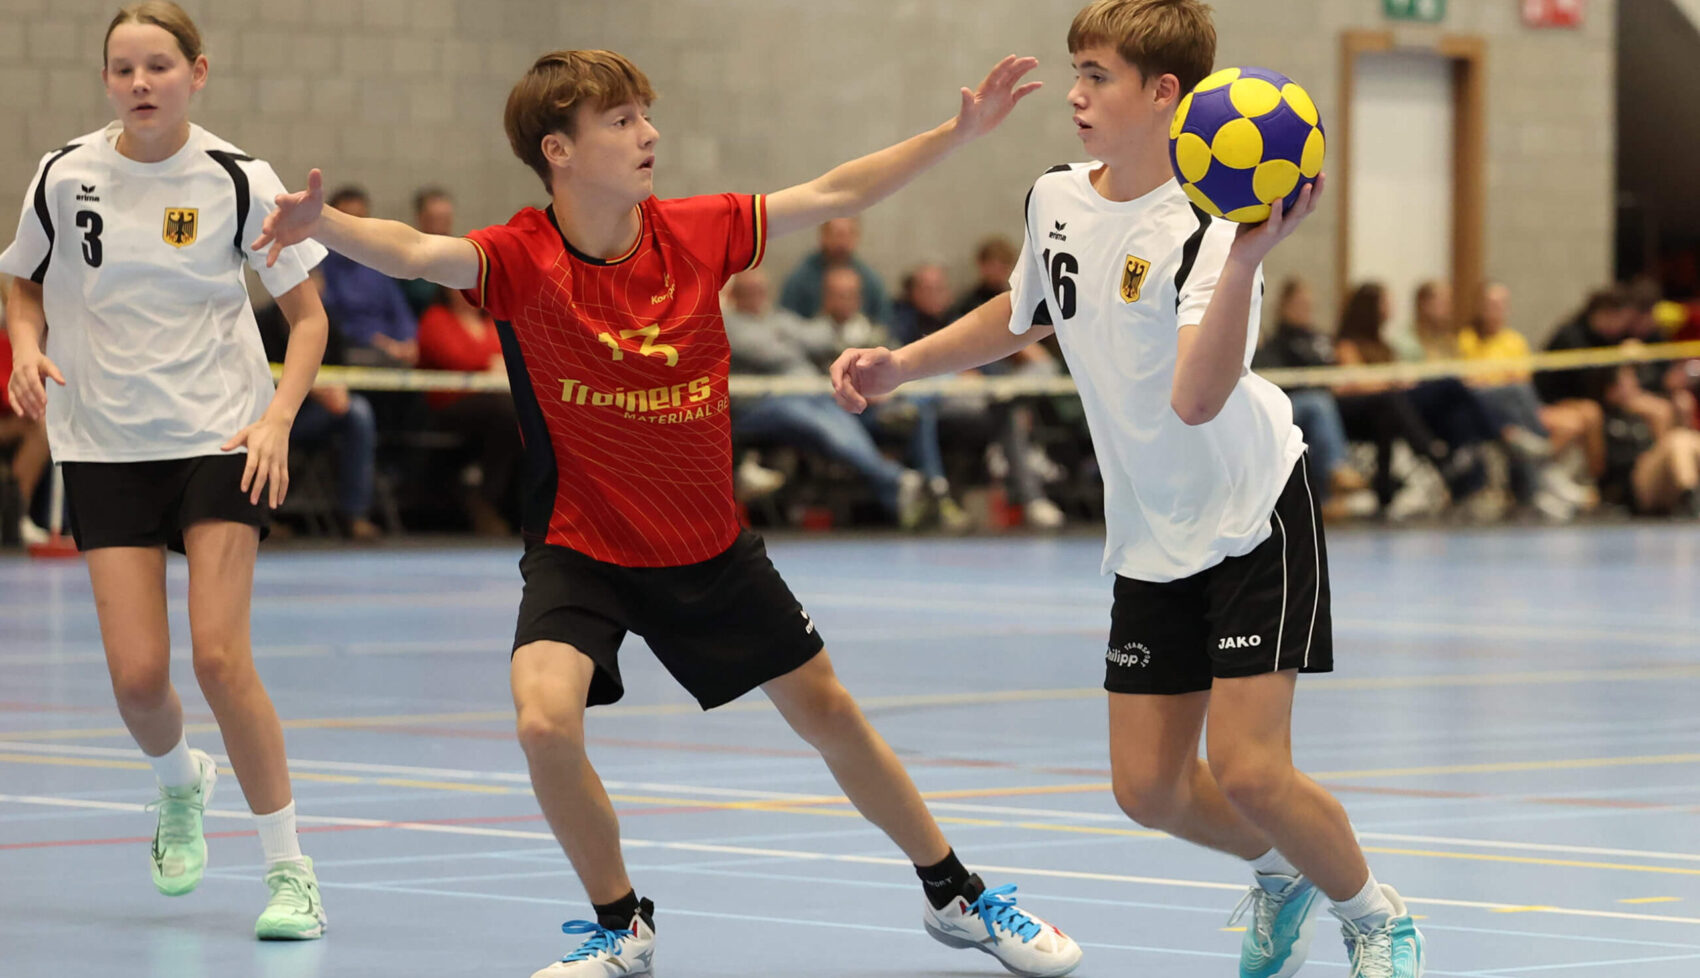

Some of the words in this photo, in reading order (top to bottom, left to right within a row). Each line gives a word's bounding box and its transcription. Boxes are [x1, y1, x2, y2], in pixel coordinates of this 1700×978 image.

[76, 194, 100, 202] erima
[75, 210, 104, 268] 3
[1049, 231, 1067, 242] erima
[598, 323, 679, 367] 13
[558, 376, 711, 412] Trainers
[1124, 642, 1151, 668] TEAMSPORT
[1217, 635, 1261, 650] JAKO
